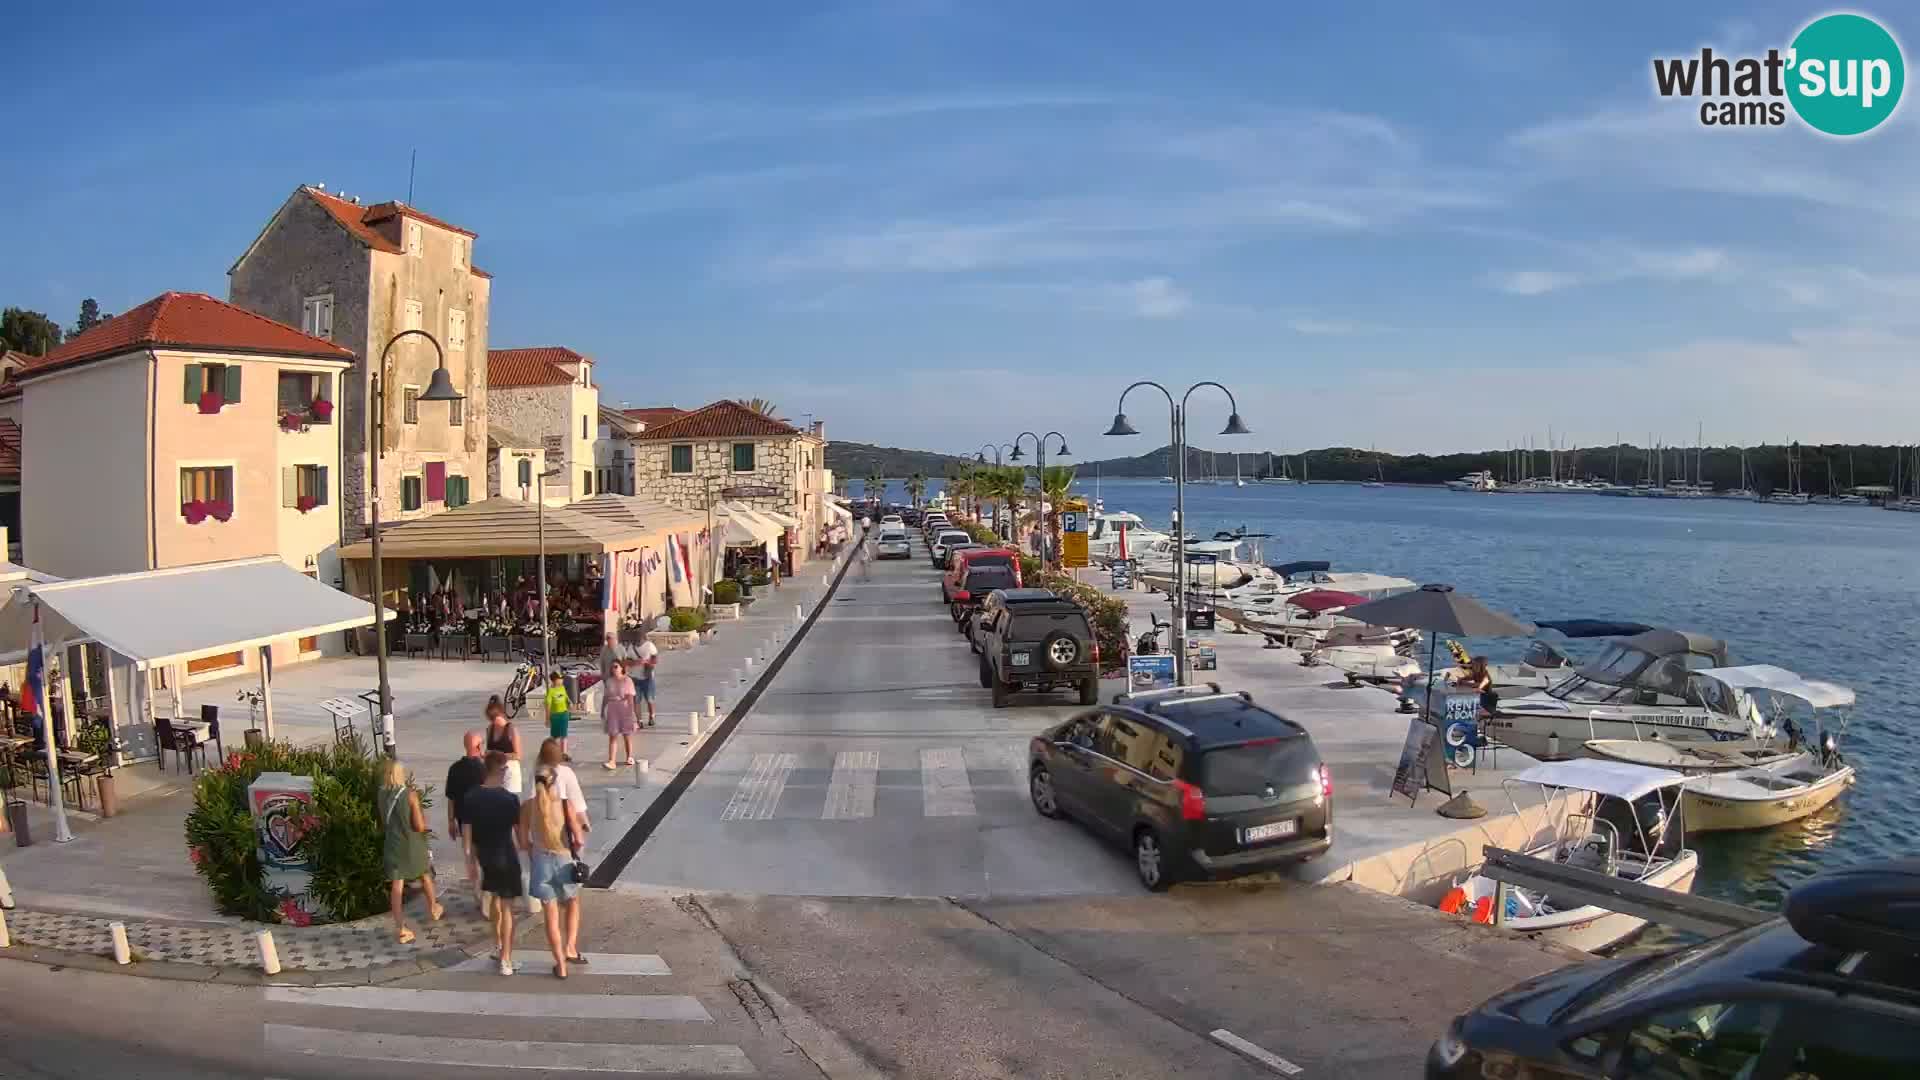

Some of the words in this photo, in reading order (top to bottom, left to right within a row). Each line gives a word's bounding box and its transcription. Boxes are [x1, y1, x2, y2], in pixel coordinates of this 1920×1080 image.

[1065, 514, 1075, 529] P
[1446, 699, 1479, 711] RENT
[1446, 711, 1453, 720] A
